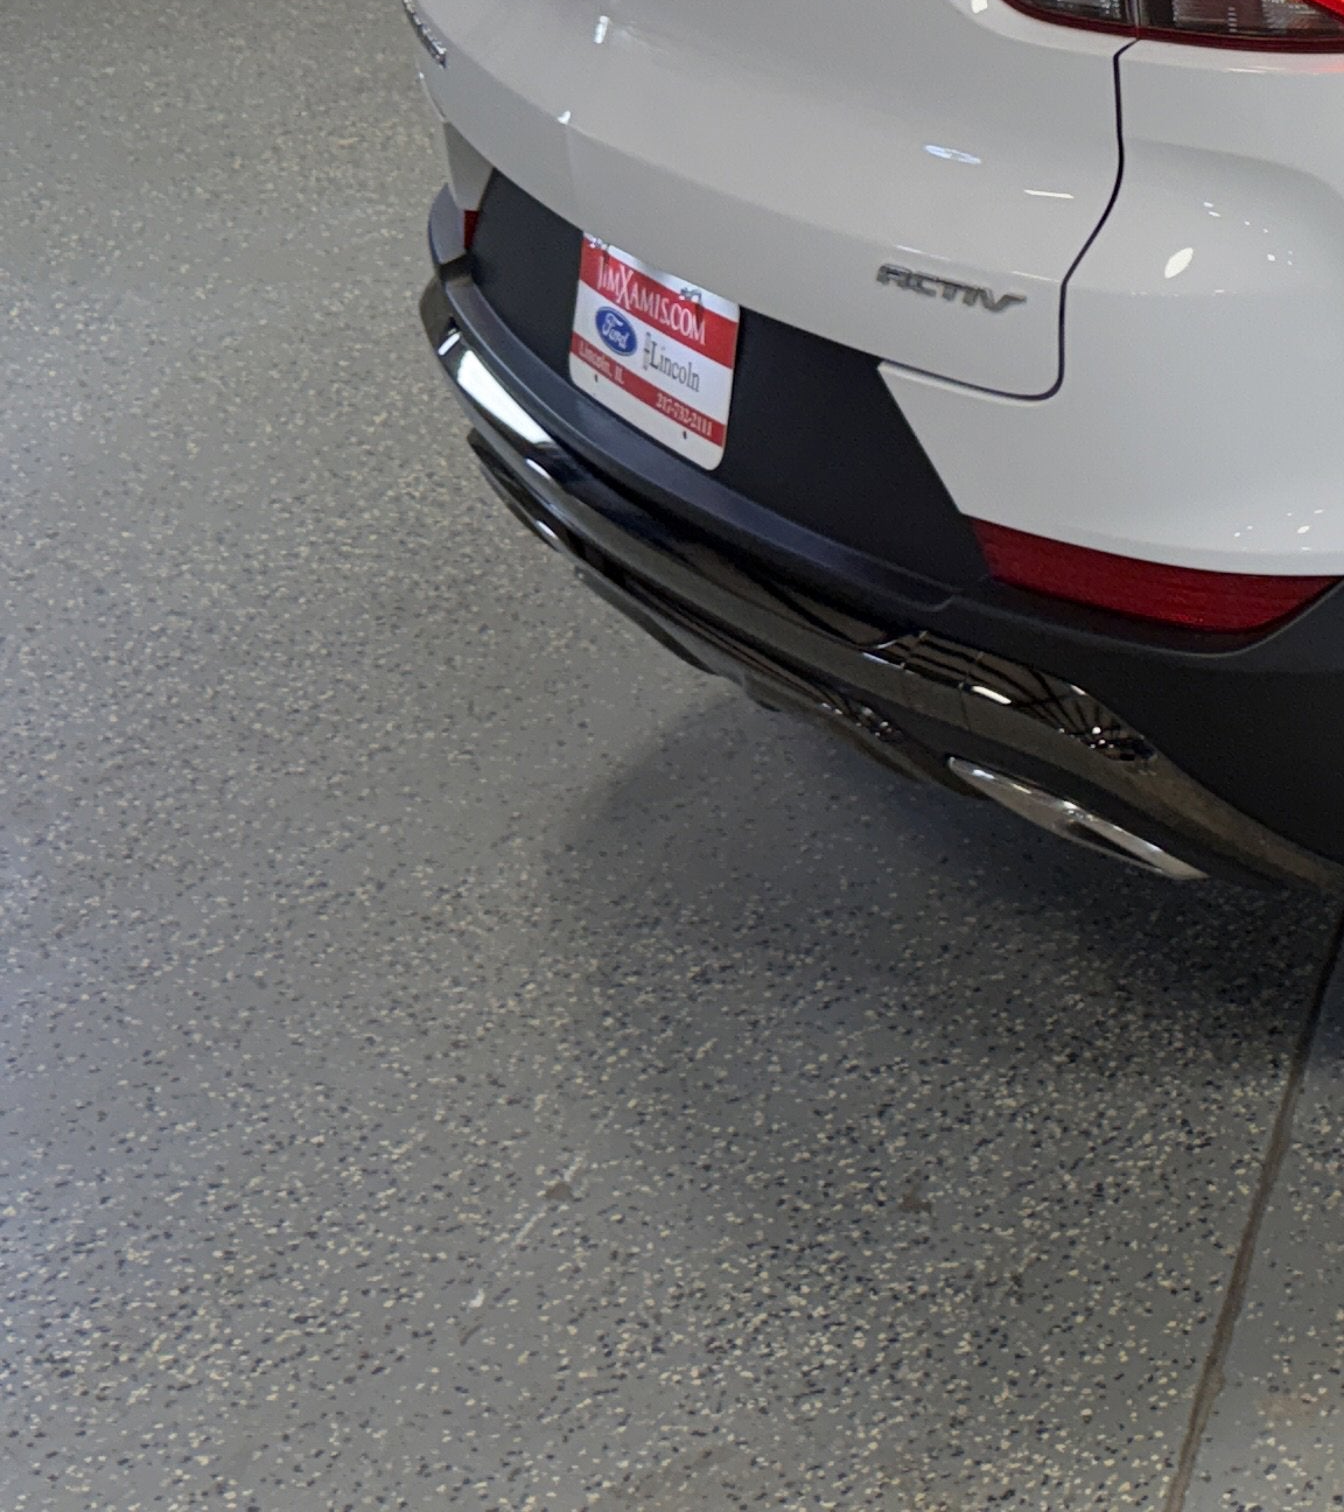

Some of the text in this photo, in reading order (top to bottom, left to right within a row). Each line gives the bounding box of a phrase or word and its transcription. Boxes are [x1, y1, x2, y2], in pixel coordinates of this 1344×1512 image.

[876, 263, 1027, 313] ACTIV
[602, 312, 629, 351] Ford
[649, 340, 701, 393] Lincoln
